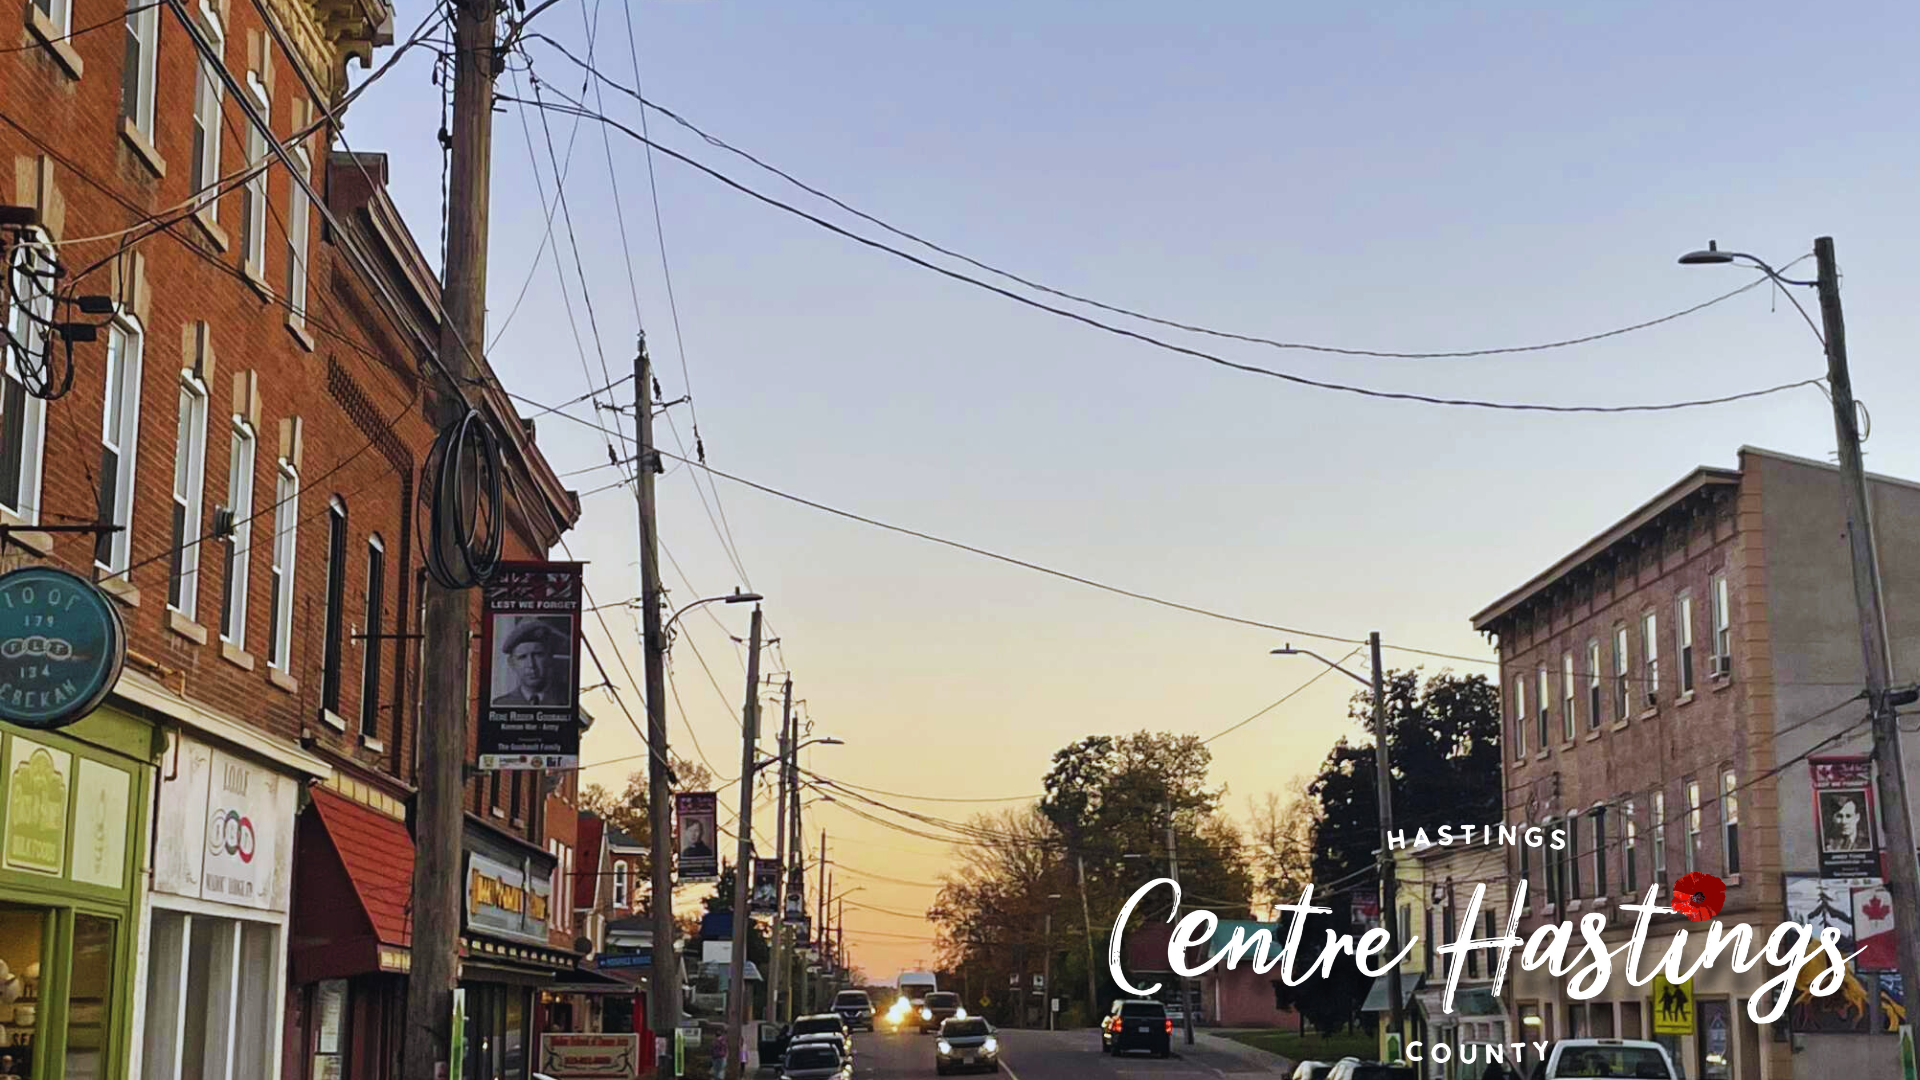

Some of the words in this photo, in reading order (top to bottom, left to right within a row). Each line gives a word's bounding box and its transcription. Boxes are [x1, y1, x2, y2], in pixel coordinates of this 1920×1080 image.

[491, 601, 516, 609] LEST
[519, 601, 535, 609] WE
[537, 601, 577, 609] FORGET
